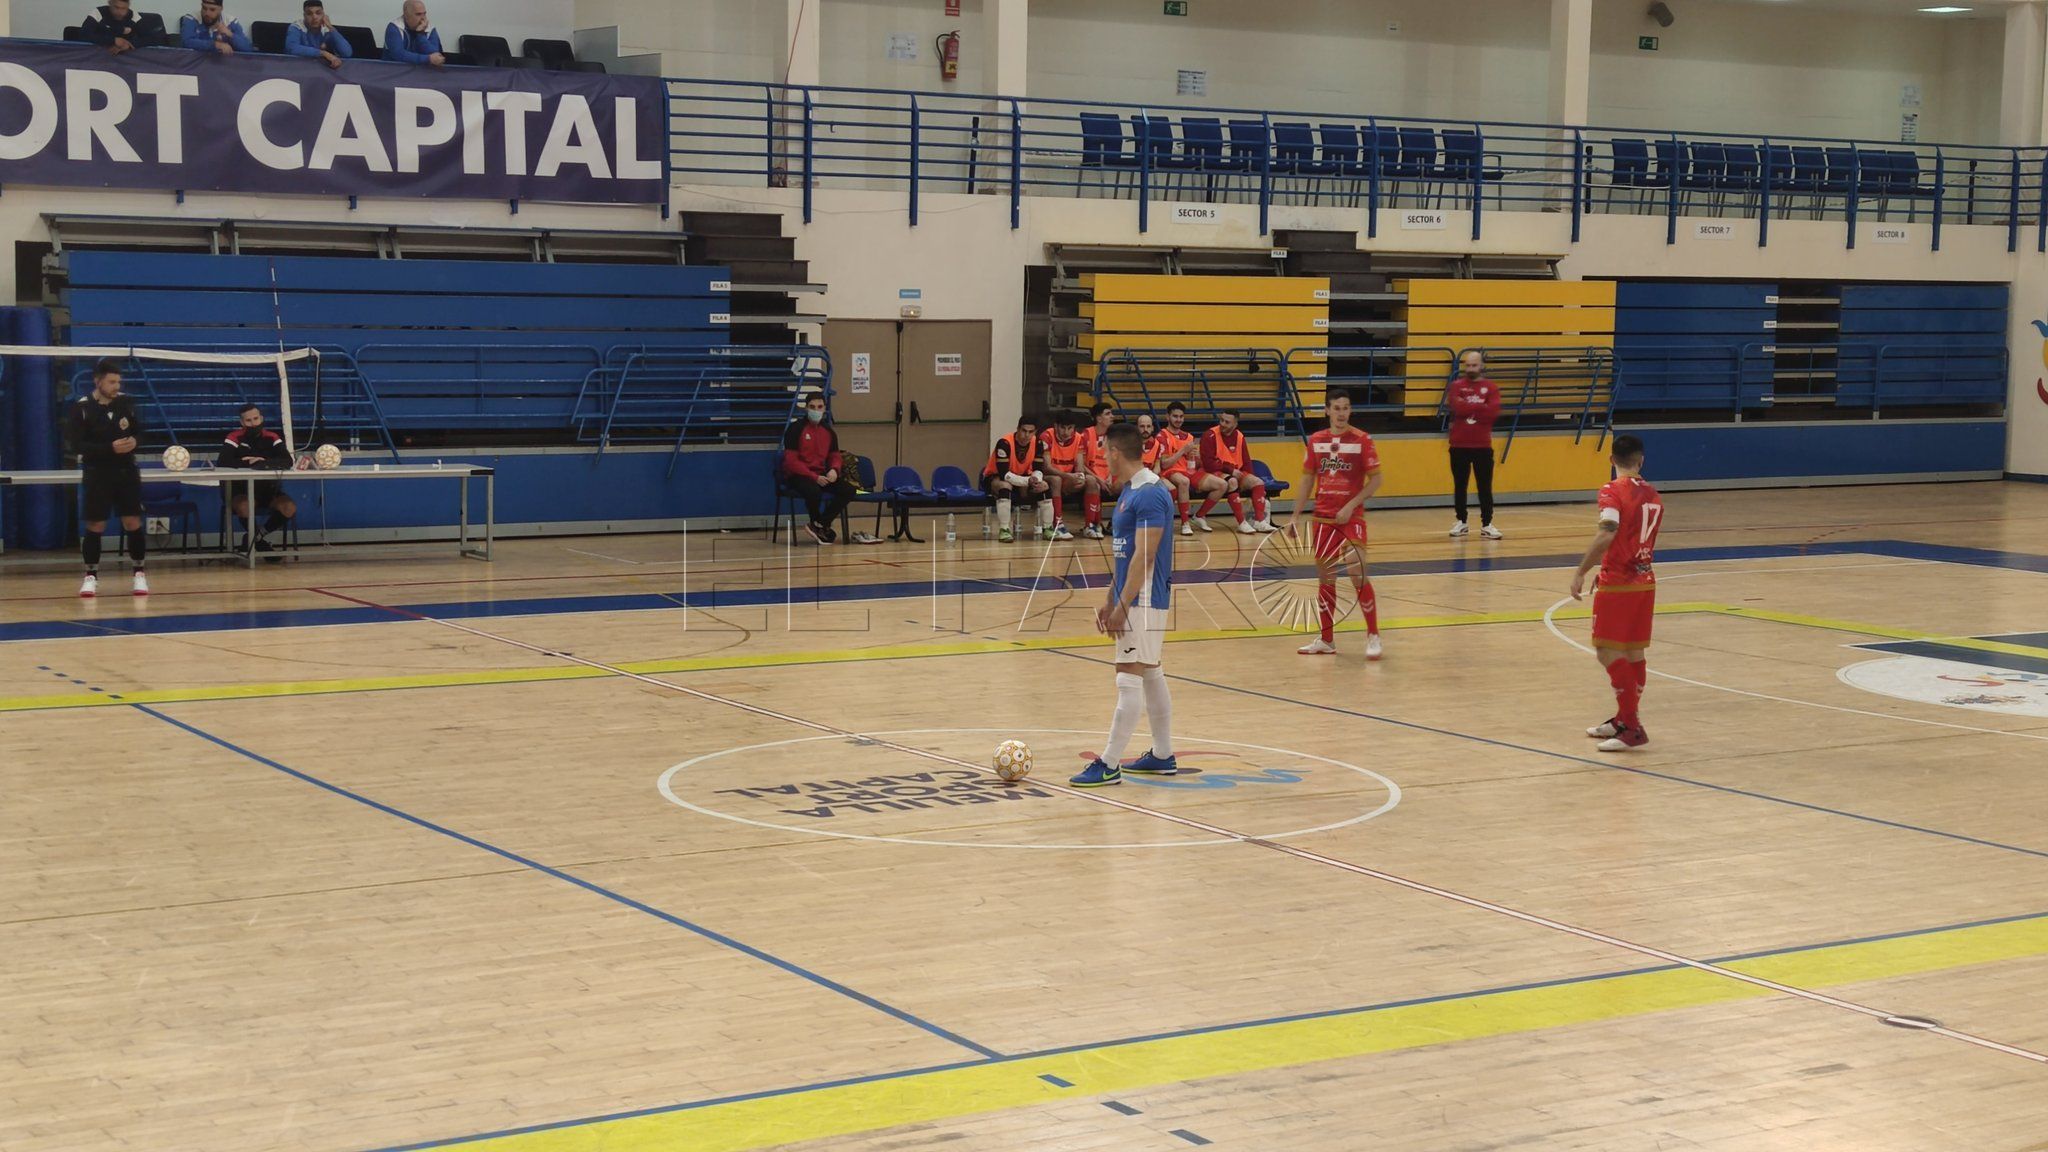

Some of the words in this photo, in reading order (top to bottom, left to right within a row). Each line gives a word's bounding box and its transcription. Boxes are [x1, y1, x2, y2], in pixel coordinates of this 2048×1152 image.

[236, 78, 663, 180] CAPITAL
[1178, 208, 1208, 218] SECTOR
[1210, 210, 1215, 218] 5
[1407, 215, 1434, 224] SECTOR
[1436, 215, 1441, 224] 6
[1700, 226, 1725, 234] SECTOR
[1877, 230, 1899, 238] SECTOR
[1319, 457, 1352, 473] Jimbee
[1640, 503, 1661, 543] 17
[713, 770, 981, 799] CAPITAL
[805, 779, 1019, 804] SPORT
[778, 788, 1054, 817] MELILLA
